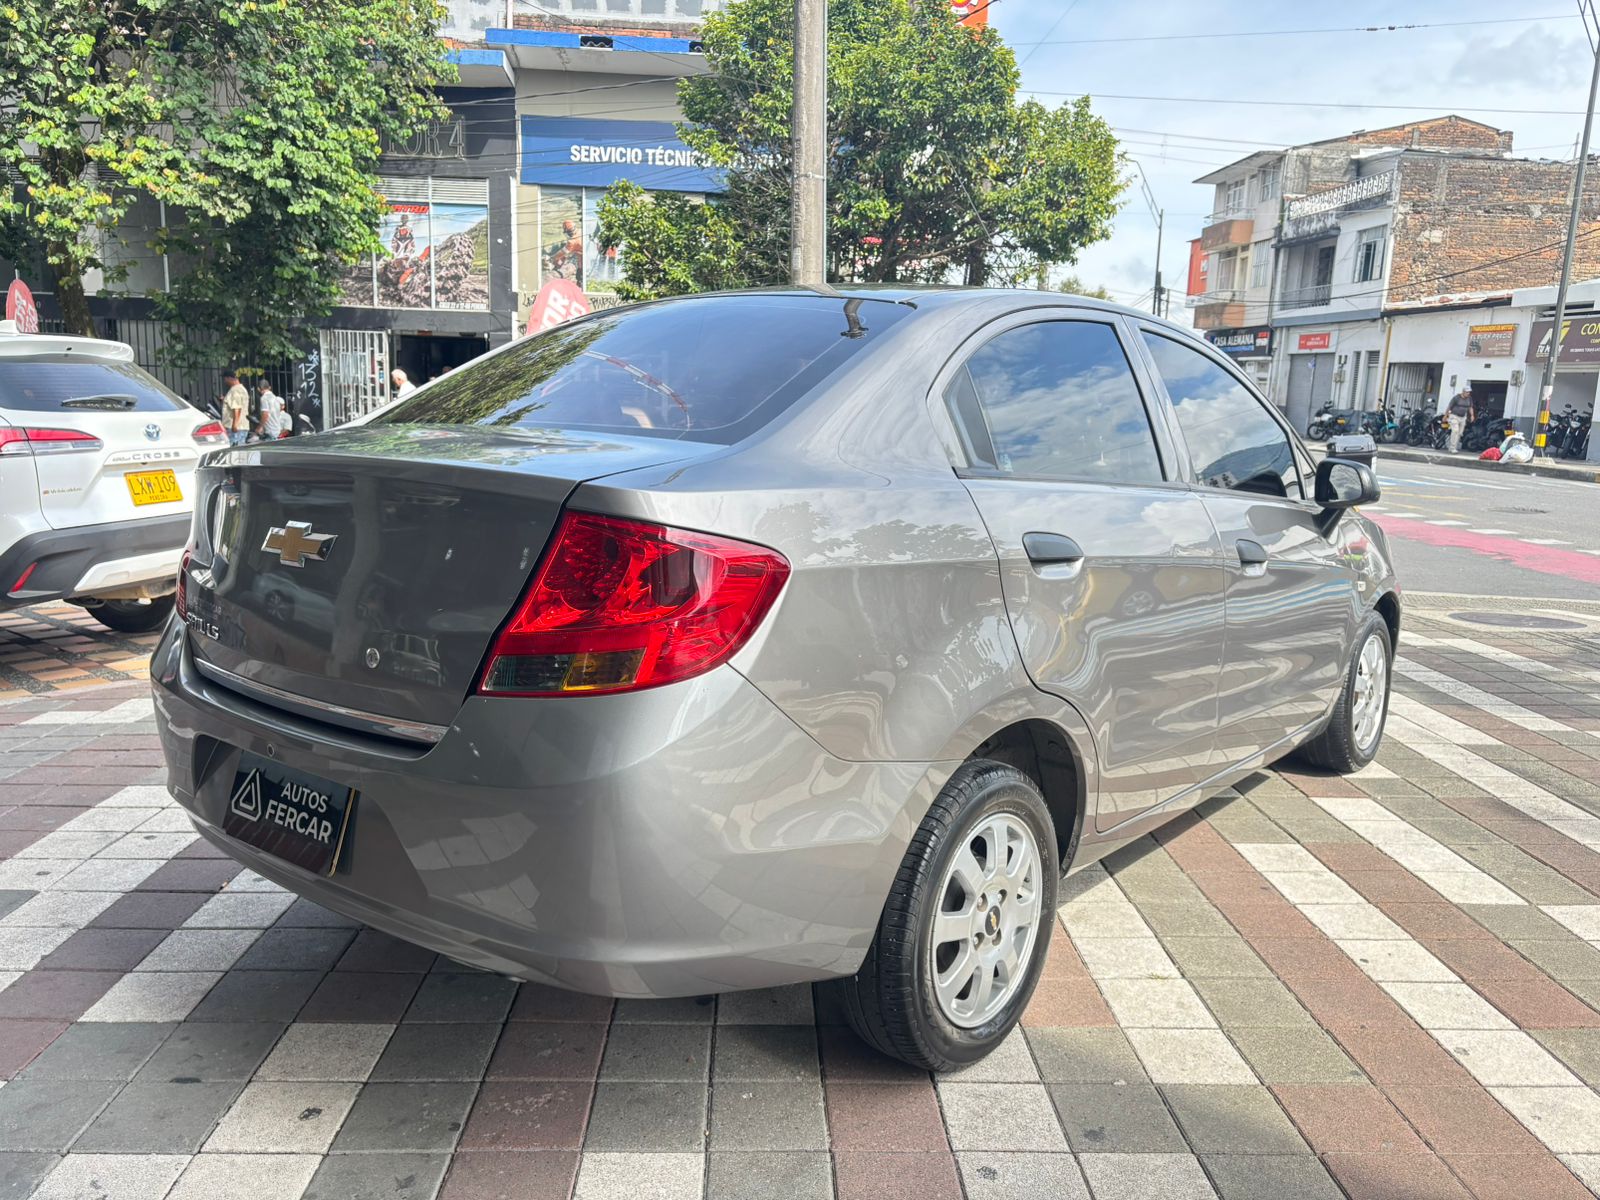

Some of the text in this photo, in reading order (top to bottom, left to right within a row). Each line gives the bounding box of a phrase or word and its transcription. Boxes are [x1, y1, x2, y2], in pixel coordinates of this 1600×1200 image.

[449, 117, 466, 160] 4
[570, 144, 642, 165] SERVICIO
[1213, 336, 1228, 347] CASA
[1228, 334, 1255, 346] ALEMANA
[299, 362, 319, 382] 13
[132, 451, 181, 461] CROSS
[280, 782, 329, 814] AUTOS
[265, 799, 333, 845] FERCAR
